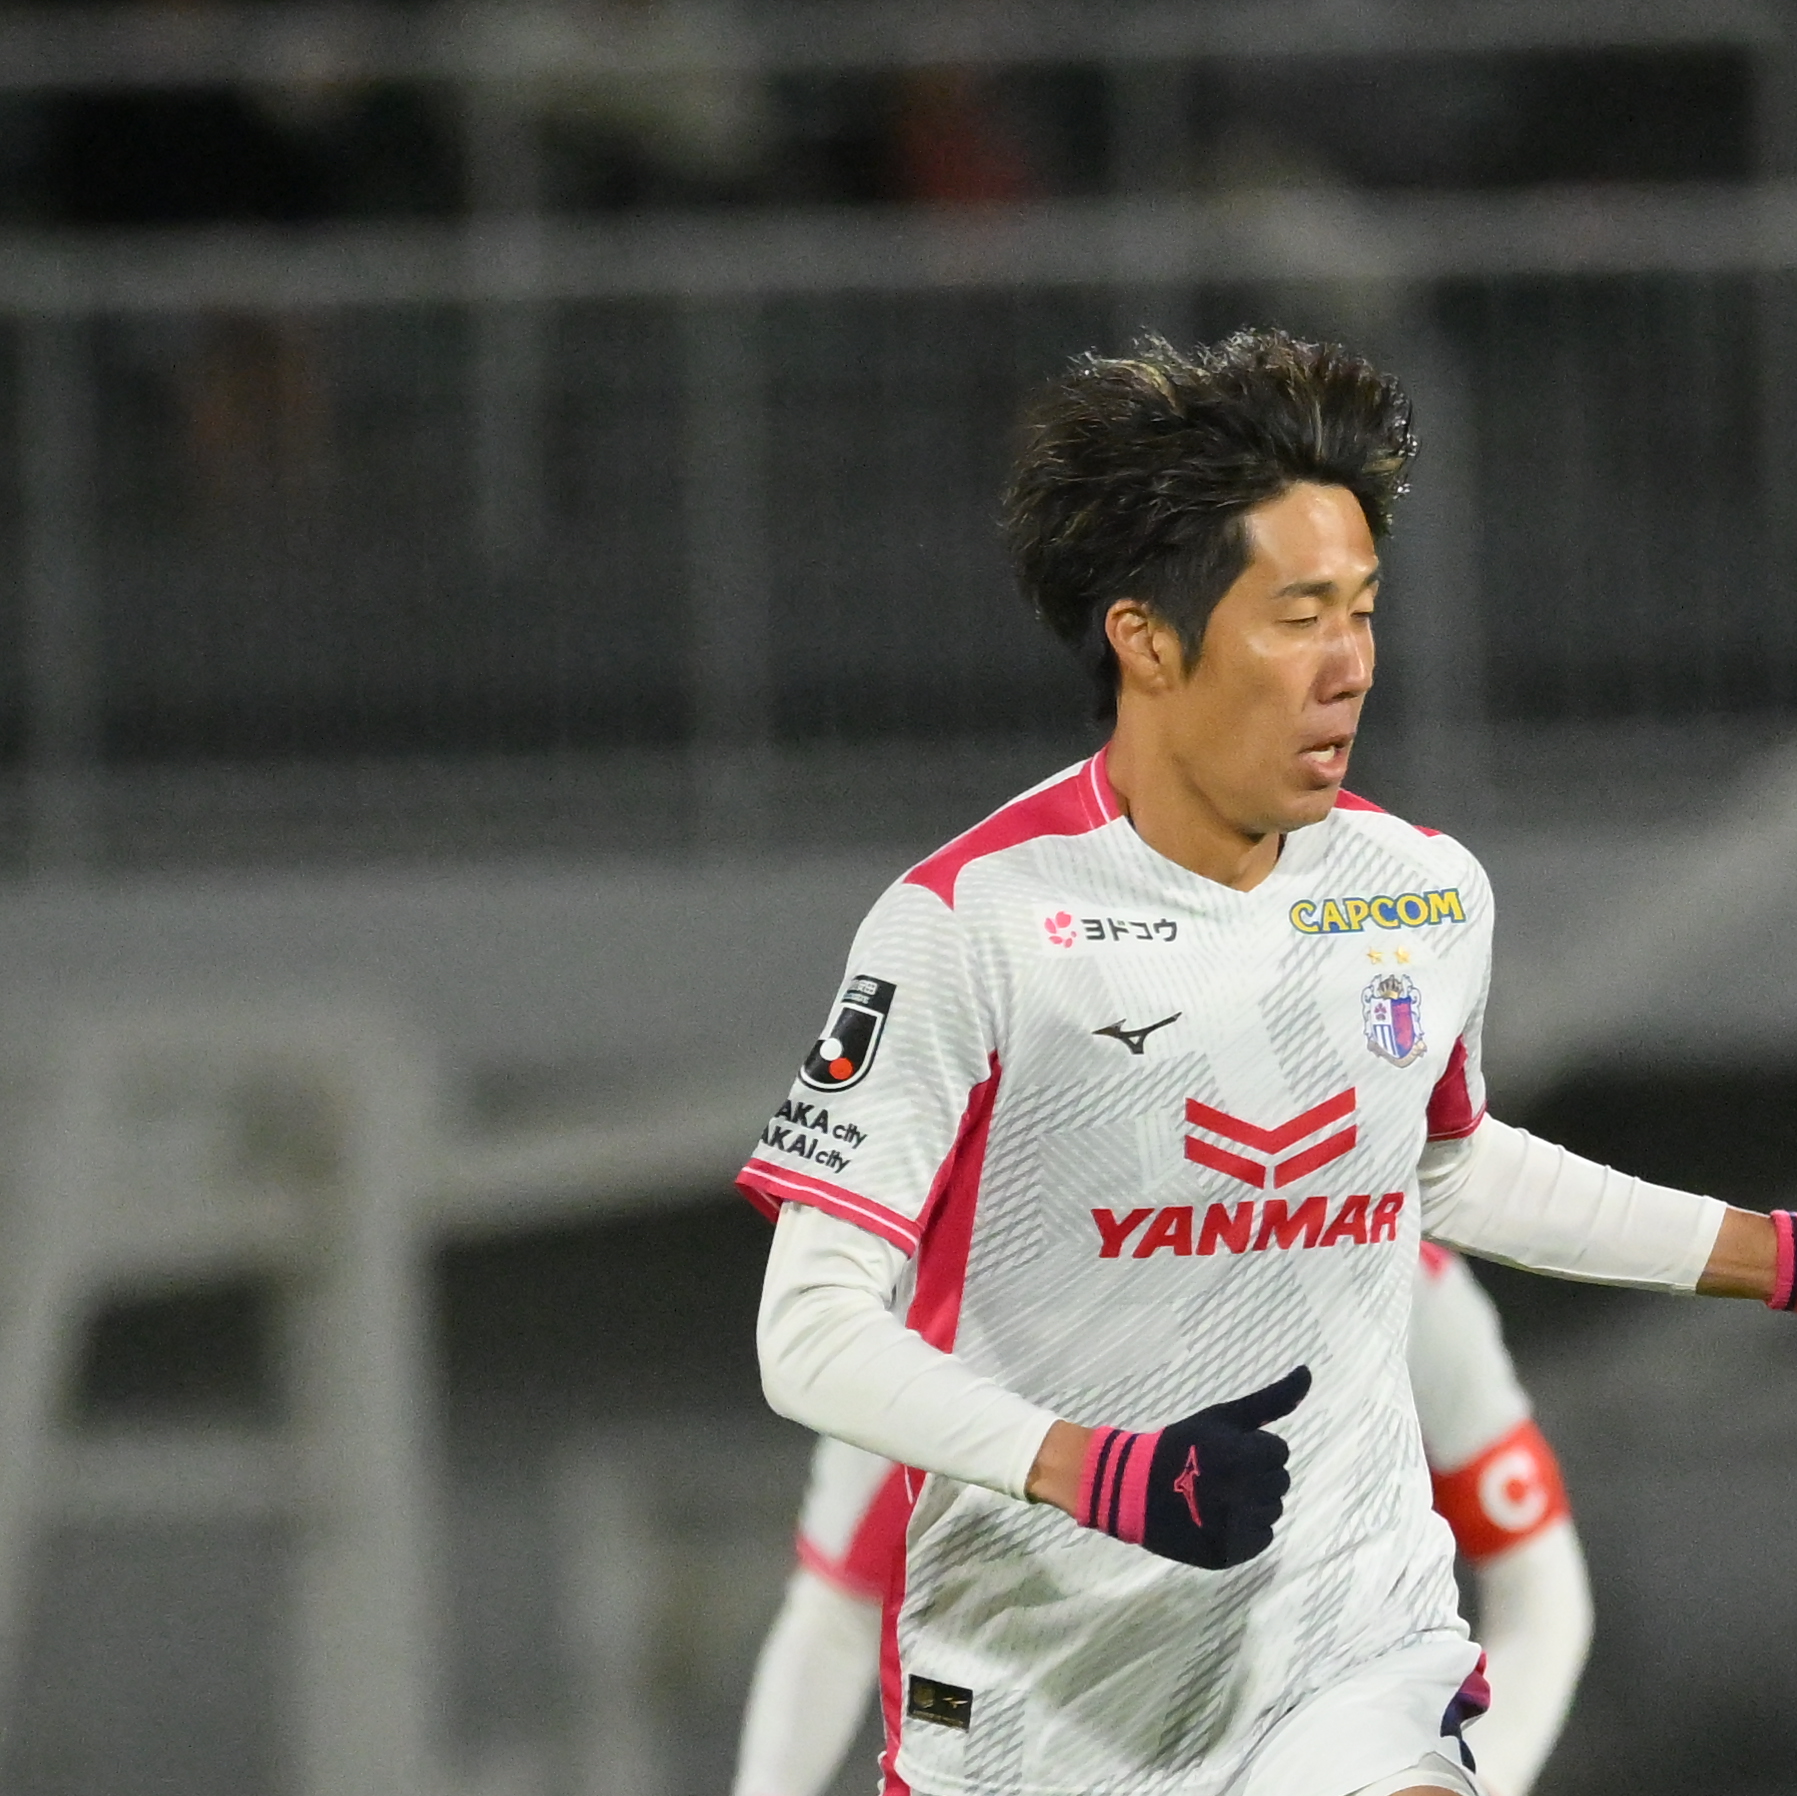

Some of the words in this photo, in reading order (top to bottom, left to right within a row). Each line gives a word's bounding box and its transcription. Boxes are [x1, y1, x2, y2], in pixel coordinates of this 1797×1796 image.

[1080, 917, 1178, 942] ヨドコウ
[1289, 888, 1466, 935] CAPCOM
[832, 1123, 868, 1149] city
[815, 1149, 852, 1174] city
[1091, 1191, 1405, 1259] YANMAR
[1478, 1446, 1549, 1532] C
